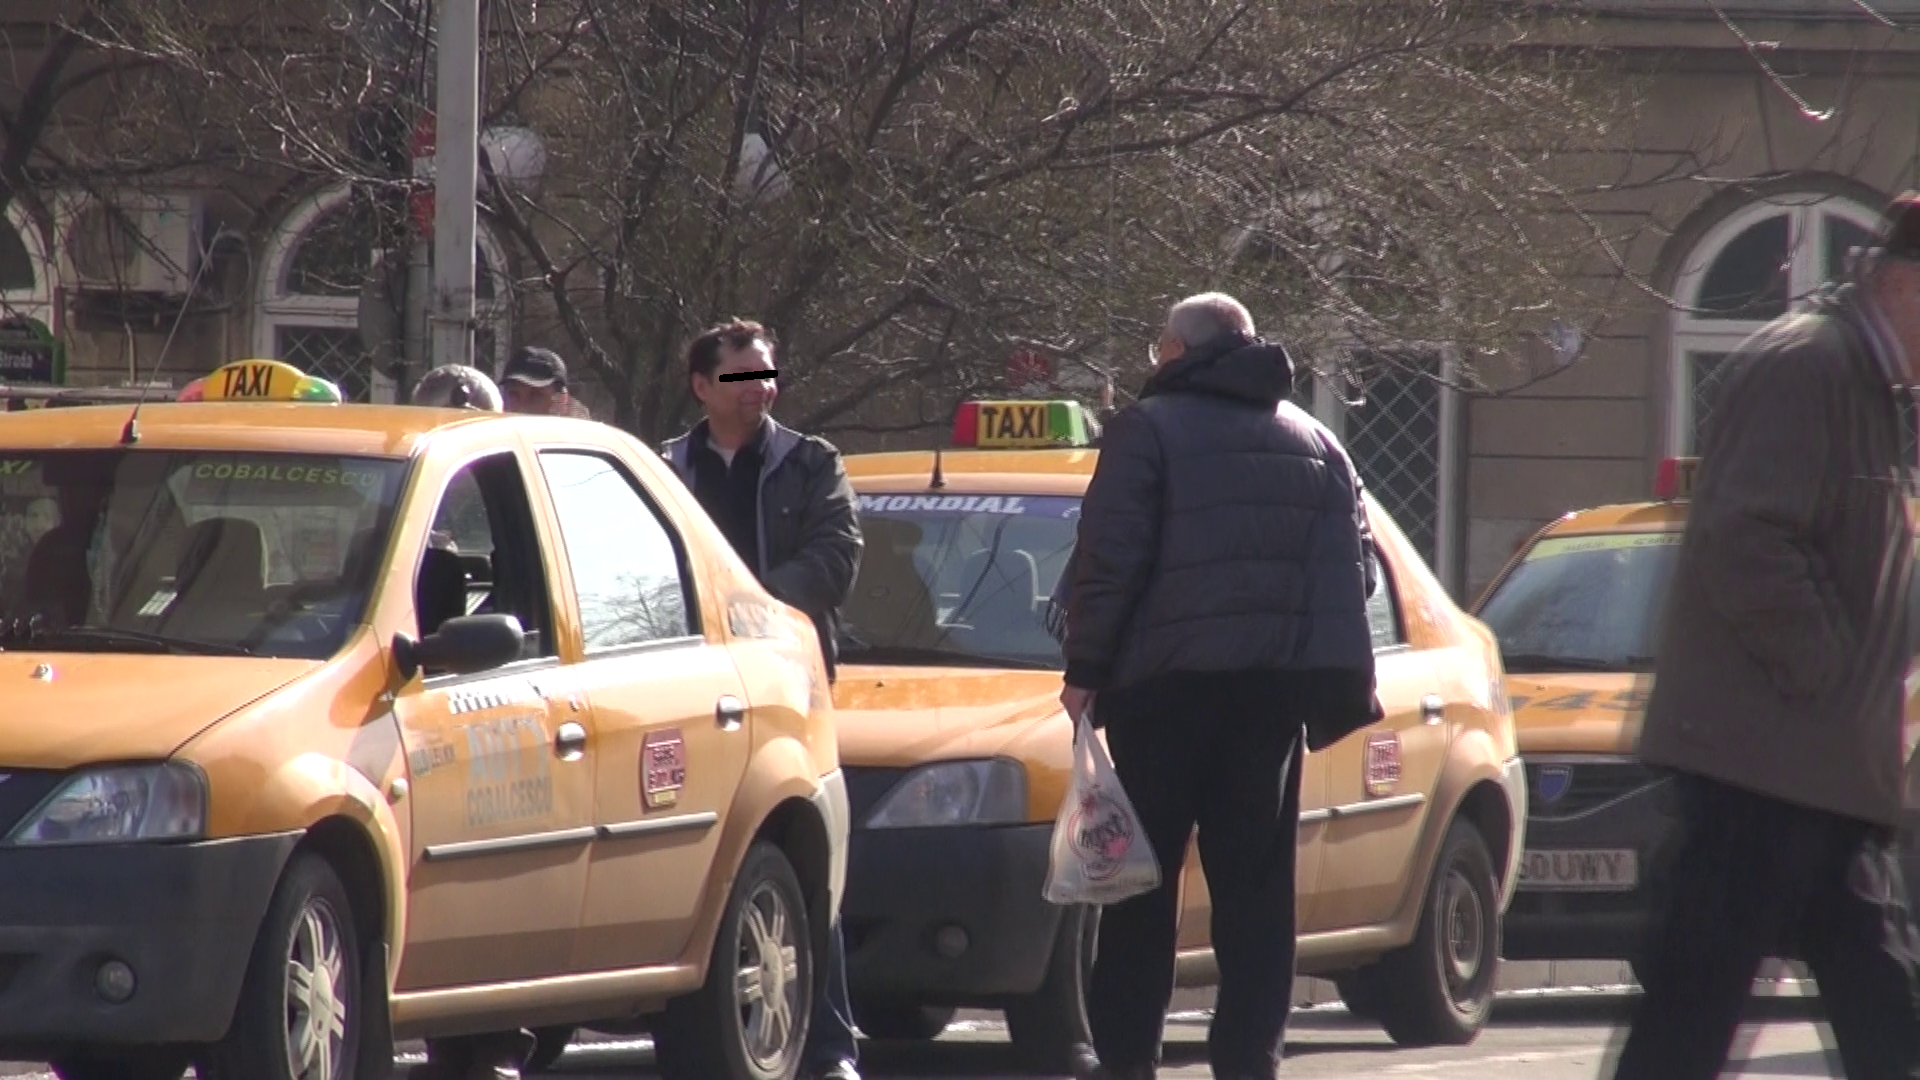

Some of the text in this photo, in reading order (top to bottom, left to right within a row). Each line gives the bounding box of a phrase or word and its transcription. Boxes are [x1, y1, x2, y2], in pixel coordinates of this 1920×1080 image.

[222, 365, 274, 398] TAXI
[981, 405, 1045, 440] TAXI
[194, 462, 380, 488] COBALCESCU
[858, 494, 1027, 515] MONDIAL
